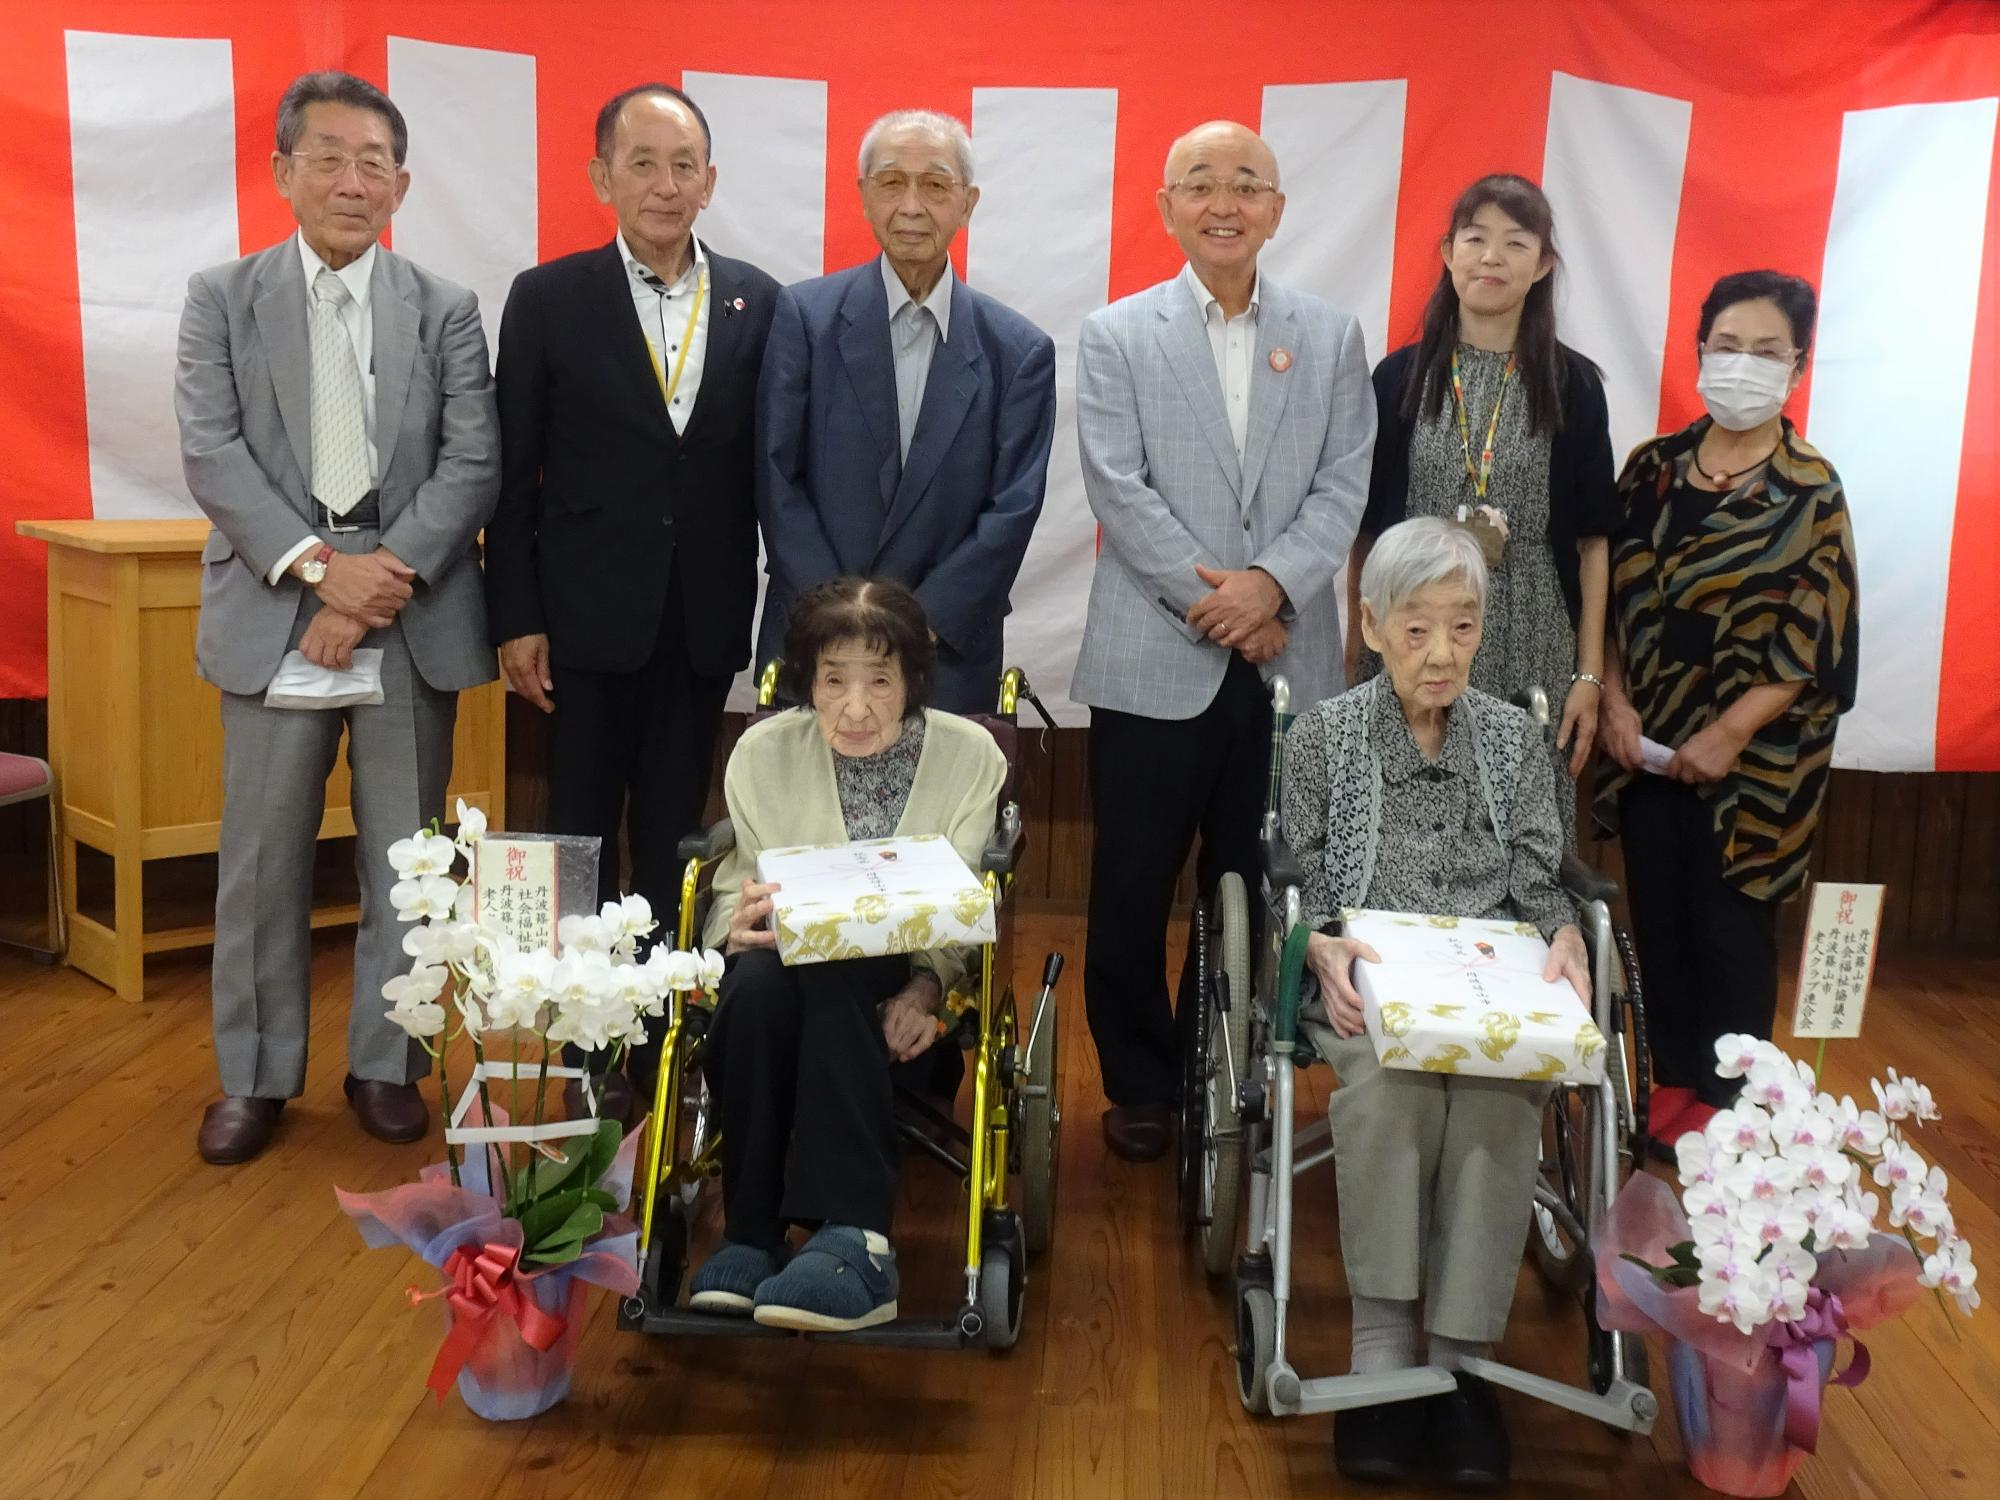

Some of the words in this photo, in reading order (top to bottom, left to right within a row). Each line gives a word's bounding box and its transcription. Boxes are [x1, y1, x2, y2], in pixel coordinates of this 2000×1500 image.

[505, 847, 527, 881] 御祝
[482, 887, 499, 918] 老人
[1836, 889, 1857, 924] 御祝
[1799, 930, 1826, 1030] 老人クラブ連合会
[1822, 928, 1842, 994] 丹波篠山市
[1830, 931, 1858, 1030] 社会福祉協議会
[1852, 928, 1871, 996] 丹波篠山市
